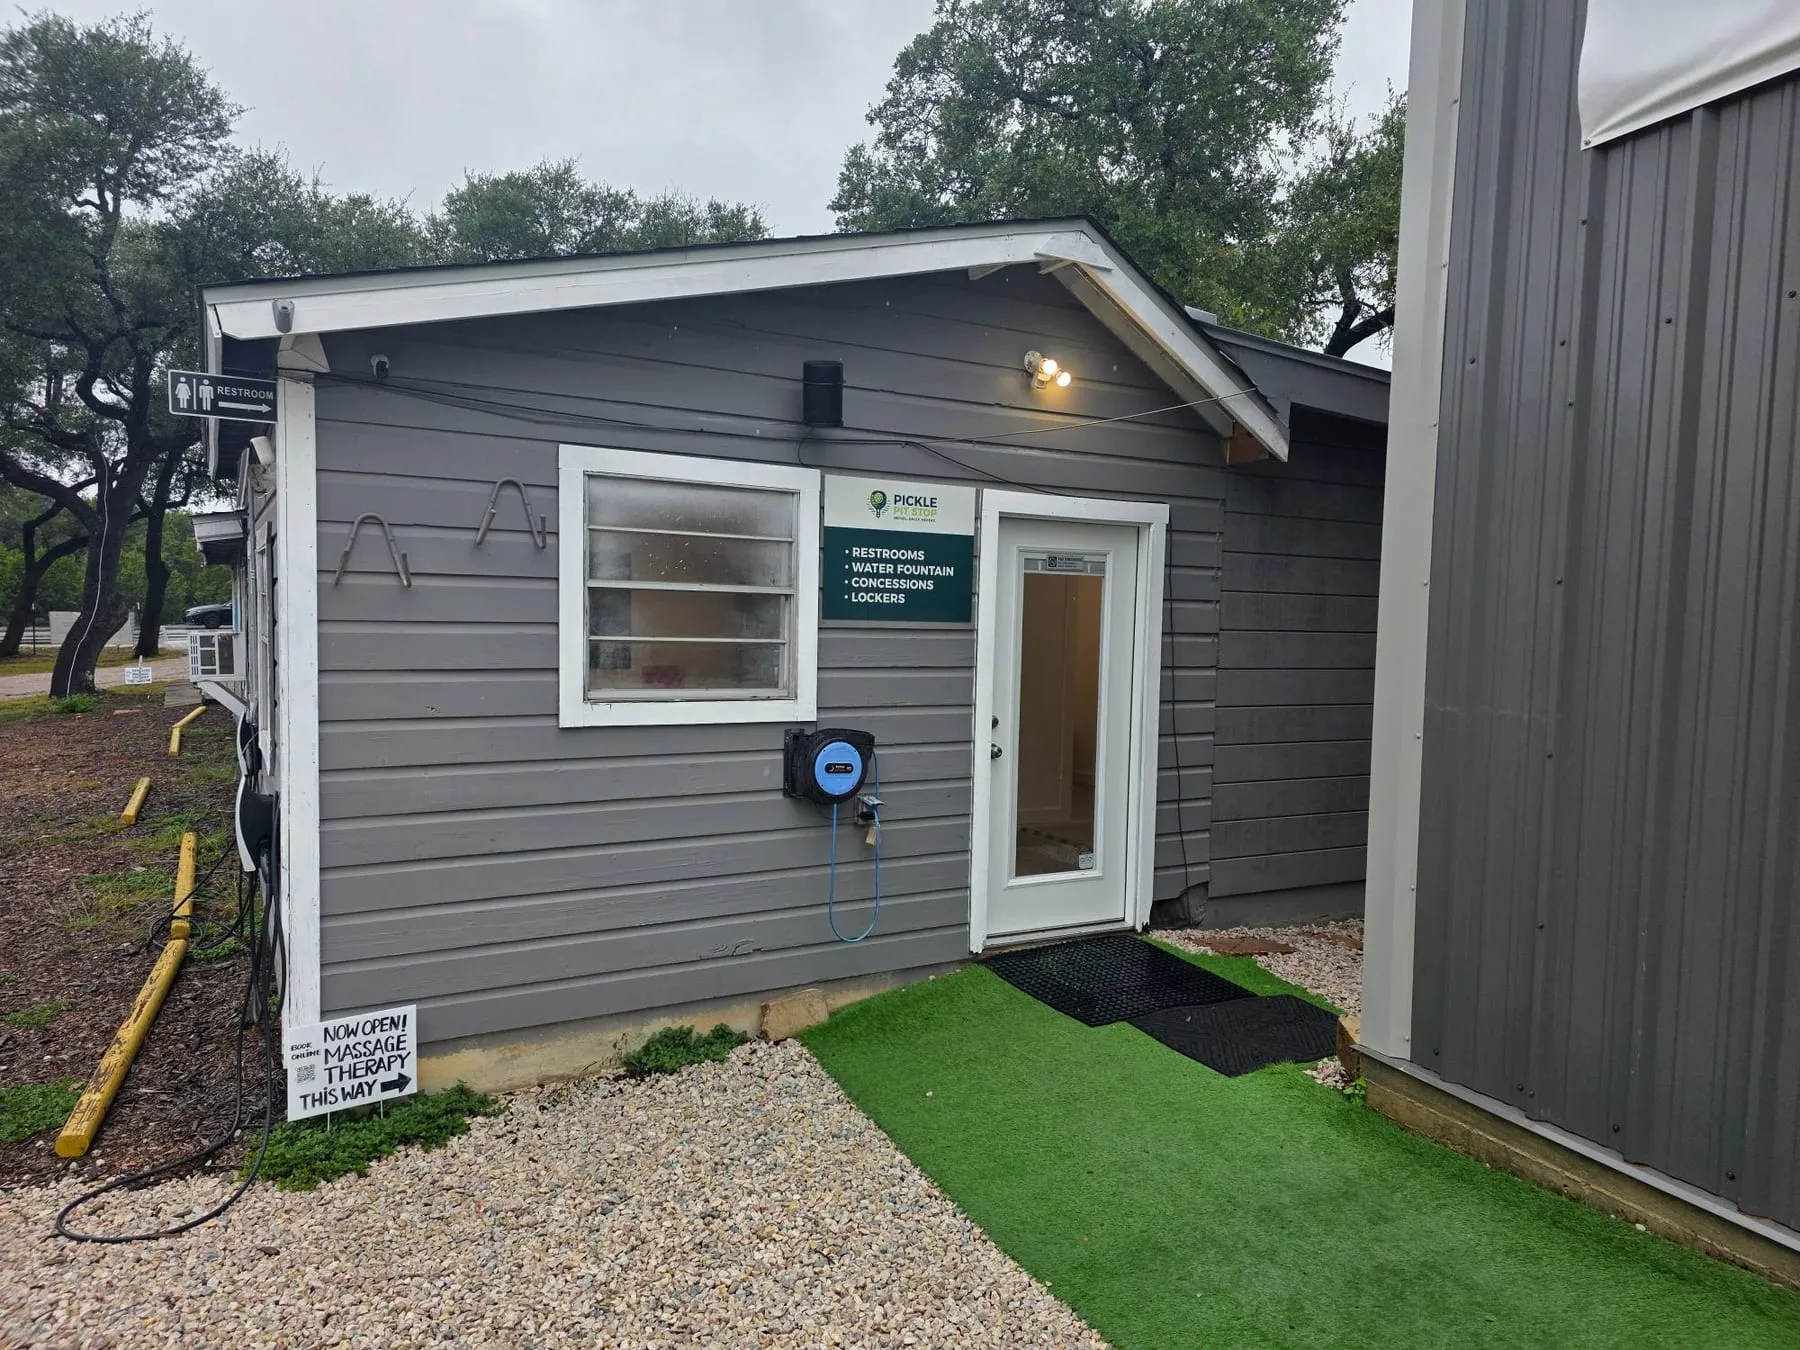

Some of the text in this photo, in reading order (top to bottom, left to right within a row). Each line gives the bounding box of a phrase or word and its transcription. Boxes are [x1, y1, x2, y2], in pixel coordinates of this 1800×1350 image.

[217, 386, 273, 400] RESTROOM
[894, 494, 937, 508] PICKLE
[893, 507, 937, 517] PIT STOP
[852, 547, 925, 561] RESTROOMS
[852, 562, 954, 577] WATER FOUNTAIN
[851, 577, 934, 590] CONCESSIONS
[851, 592, 906, 604] LOCKERS
[324, 1014, 408, 1043] NOW OPEN!
[290, 1042, 312, 1051] BOOK
[324, 1033, 407, 1065] MASSAGE
[323, 1051, 411, 1085] THERAPY
[341, 1079, 378, 1101] WAY
